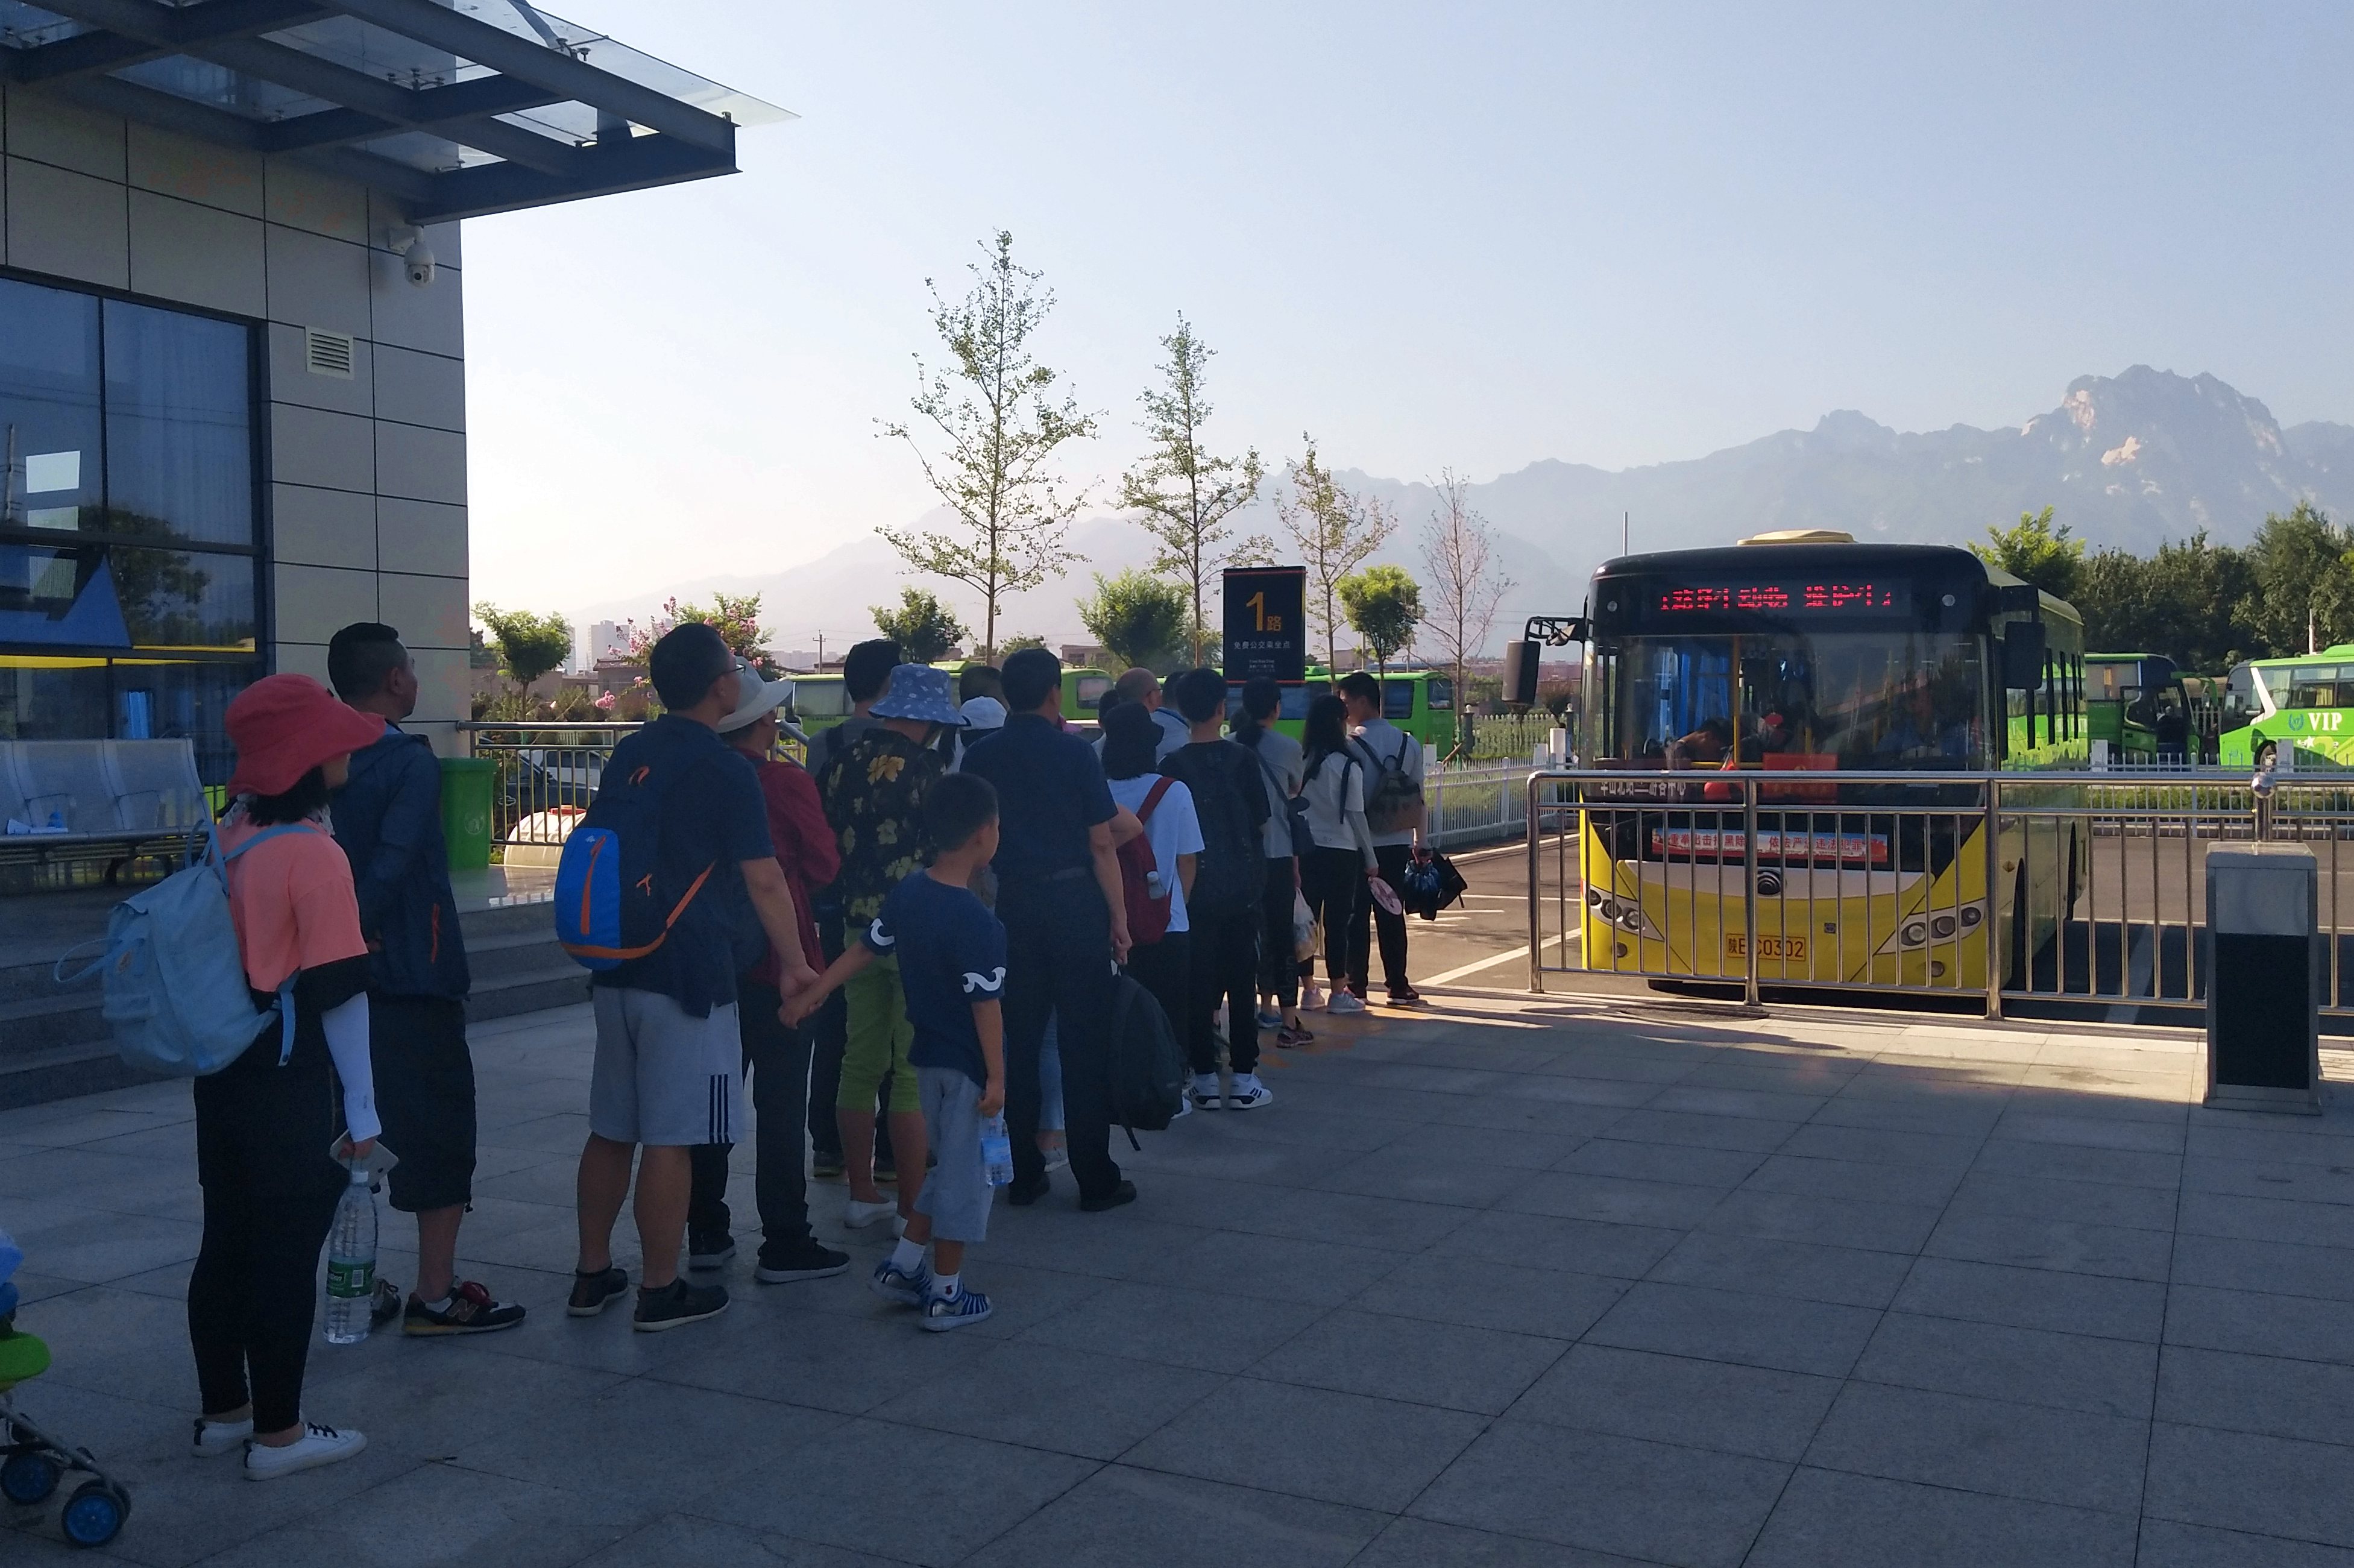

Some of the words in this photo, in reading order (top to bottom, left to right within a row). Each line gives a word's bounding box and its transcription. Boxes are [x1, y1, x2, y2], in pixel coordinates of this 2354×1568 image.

[2308, 712, 2343, 731] VIP
[1670, 833, 1749, 847] 重拳出击黑除
